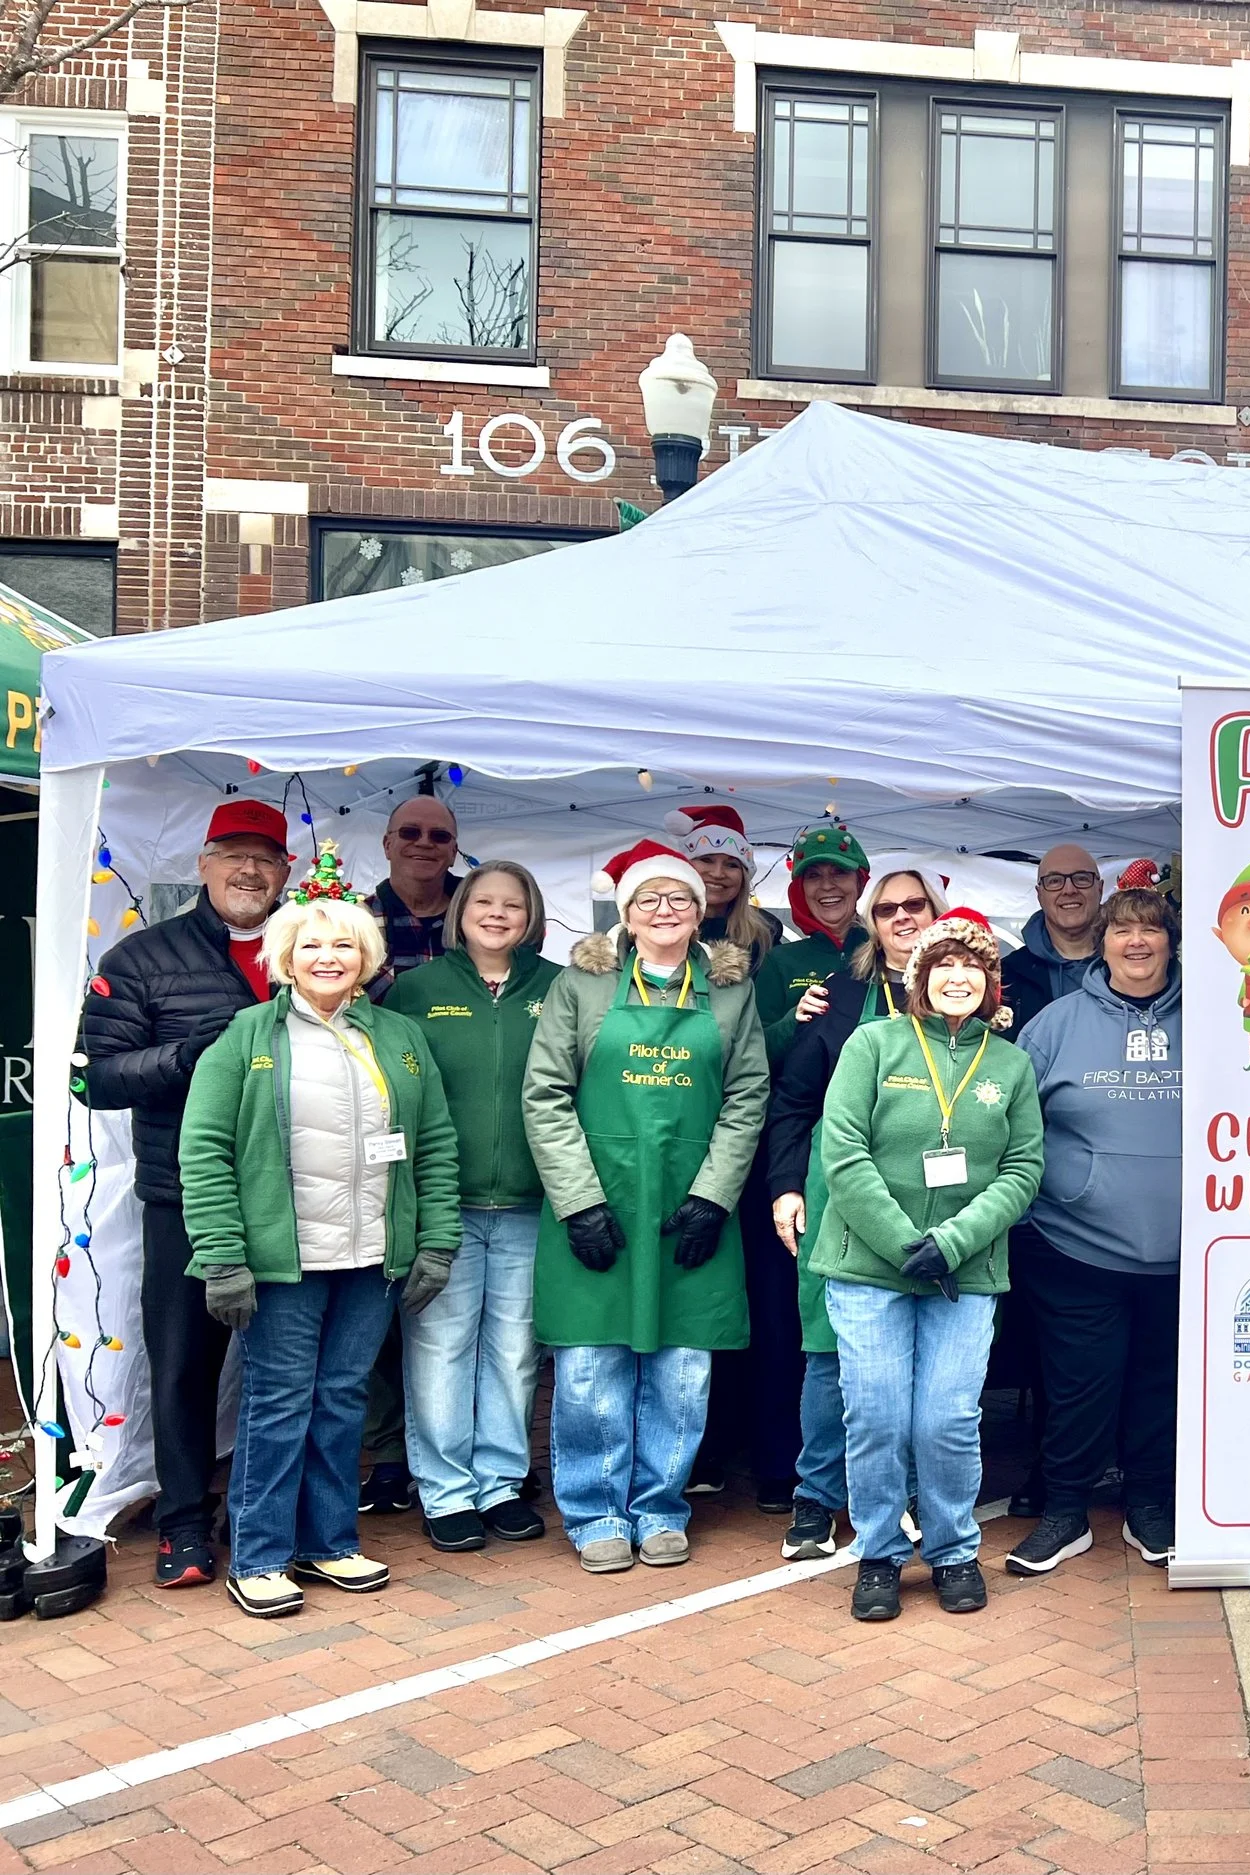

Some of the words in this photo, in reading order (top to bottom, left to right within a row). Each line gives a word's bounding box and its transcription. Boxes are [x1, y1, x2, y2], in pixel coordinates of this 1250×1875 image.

[440, 411, 616, 482] 106
[629, 1043, 660, 1058] Pilot
[661, 1046, 691, 1060] Club
[652, 1061, 667, 1074] of
[622, 1070, 673, 1086] Sumner
[674, 1073, 693, 1087] Co.
[1083, 1070, 1131, 1084] FIRST
[1136, 1070, 1182, 1084] BAPT
[1107, 1090, 1180, 1100] GALLATIN
